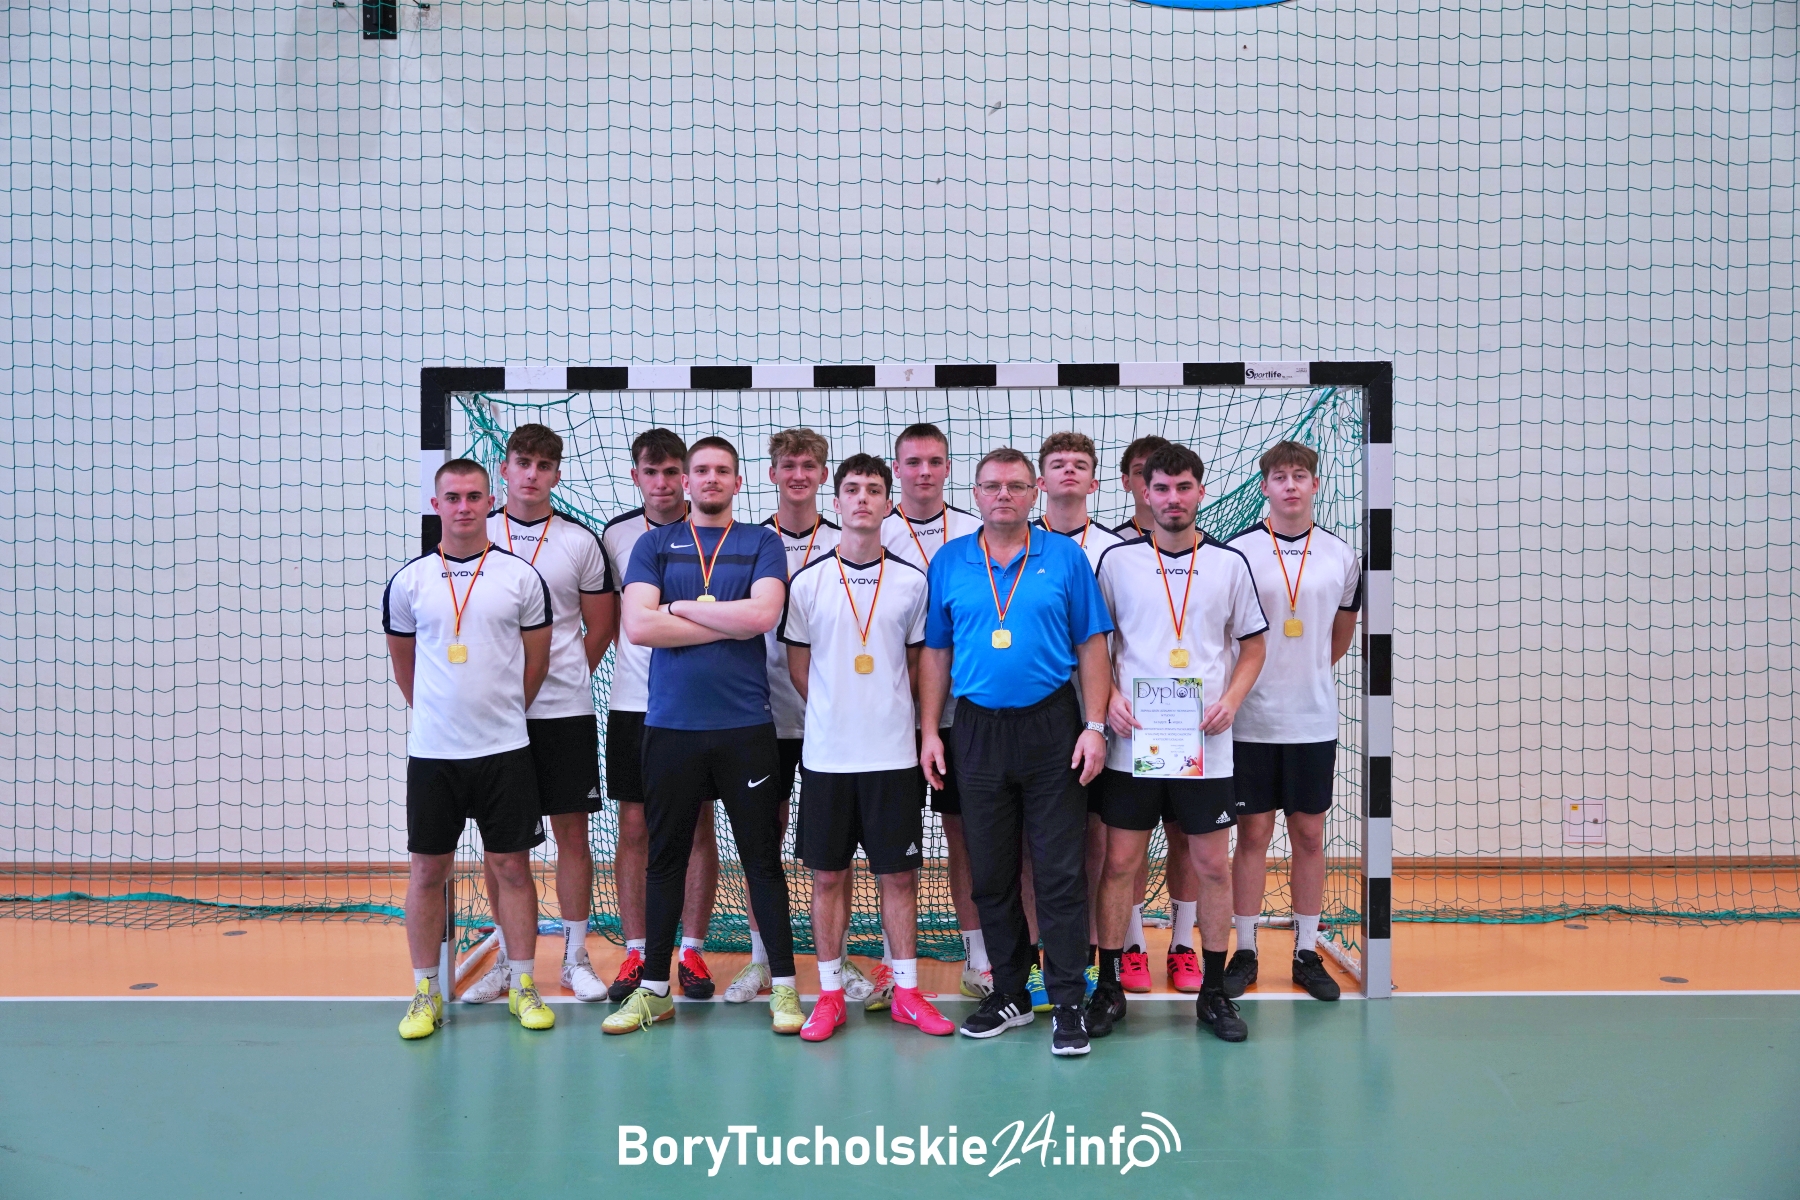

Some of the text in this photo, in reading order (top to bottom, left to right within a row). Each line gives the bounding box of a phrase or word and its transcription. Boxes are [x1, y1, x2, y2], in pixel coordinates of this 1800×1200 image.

[1246, 368, 1282, 379] Sportlife
[441, 570, 484, 578] GIVOVA
[1156, 568, 1199, 576] GIVOVA
[1136, 681, 1200, 704] Dyplom
[1215, 817, 1231, 825] adidas
